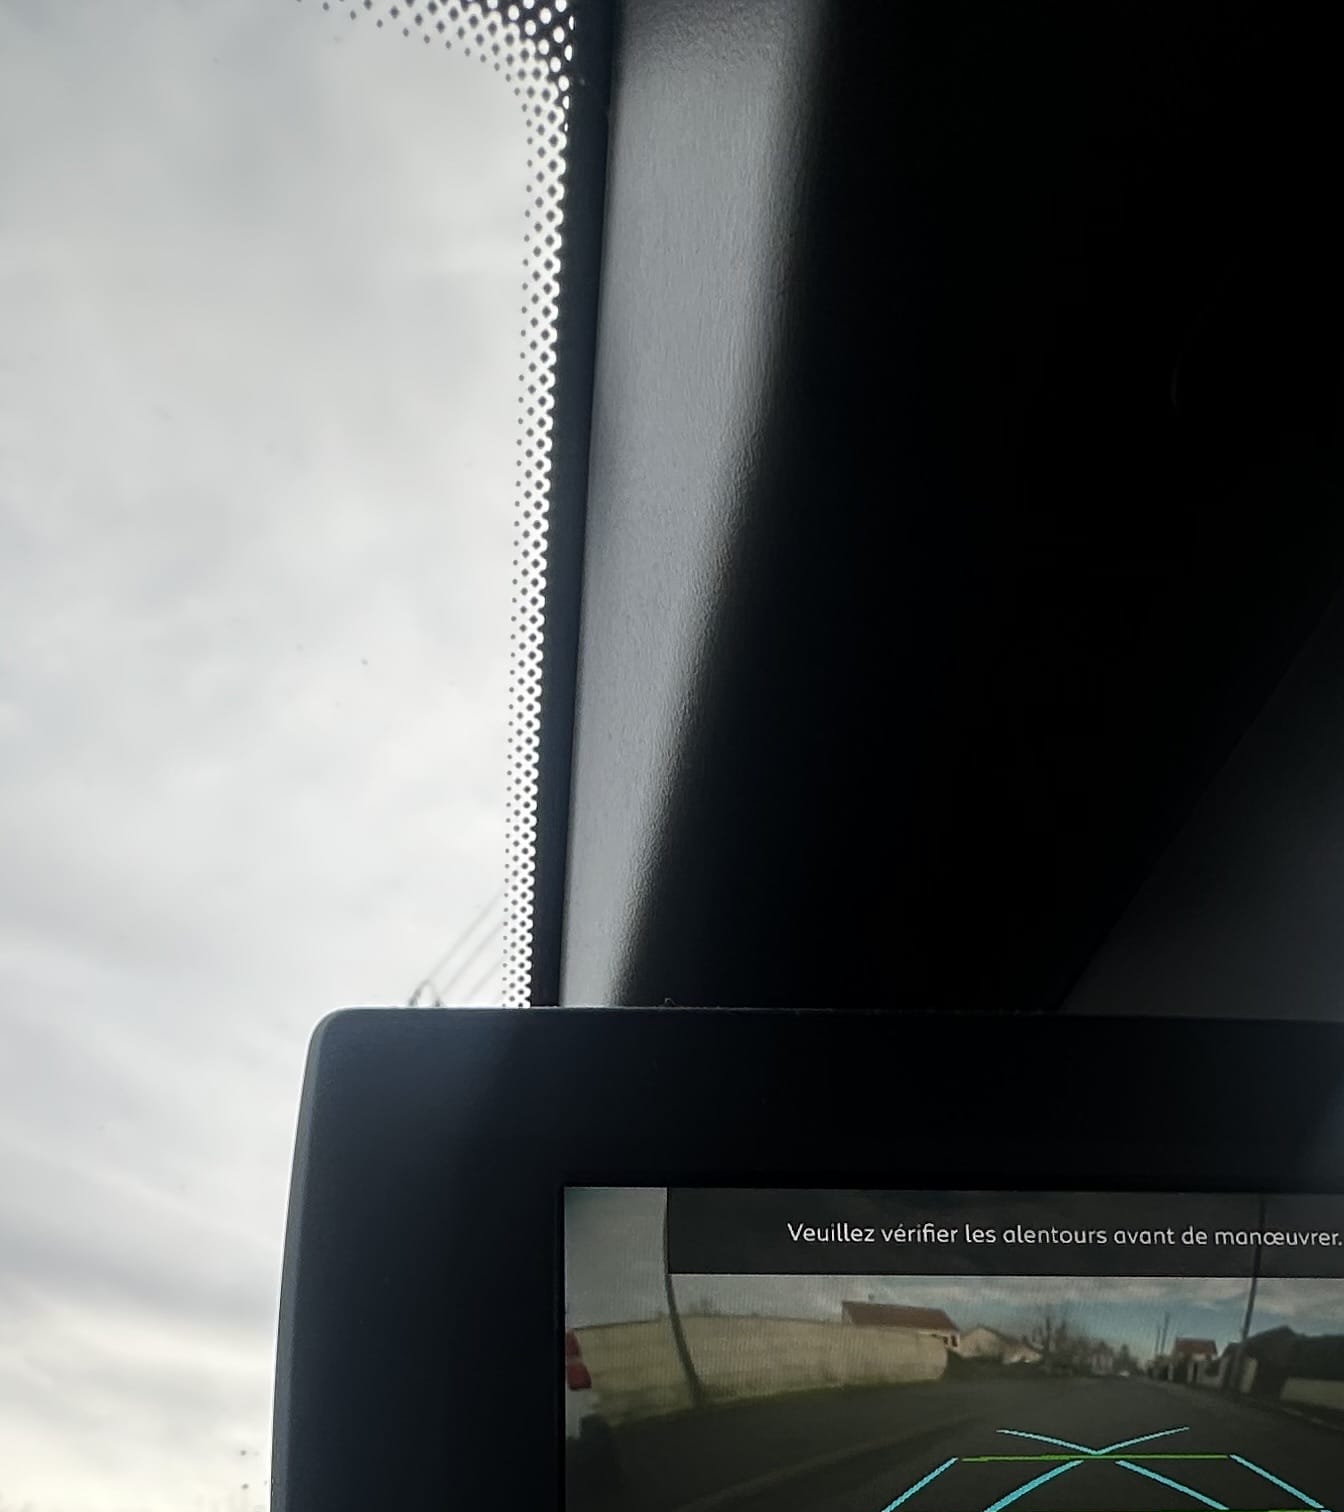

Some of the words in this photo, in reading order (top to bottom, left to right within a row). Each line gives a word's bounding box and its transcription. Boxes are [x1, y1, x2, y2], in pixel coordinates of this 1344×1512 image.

[786, 1222, 876, 1243] Veuillez
[880, 1222, 959, 1243] vérifier
[965, 1223, 997, 1244] les
[1002, 1224, 1108, 1245] alentours
[1113, 1227, 1176, 1245] avant
[1181, 1225, 1208, 1245] de
[1214, 1229, 1344, 1247] manœuvrer.
